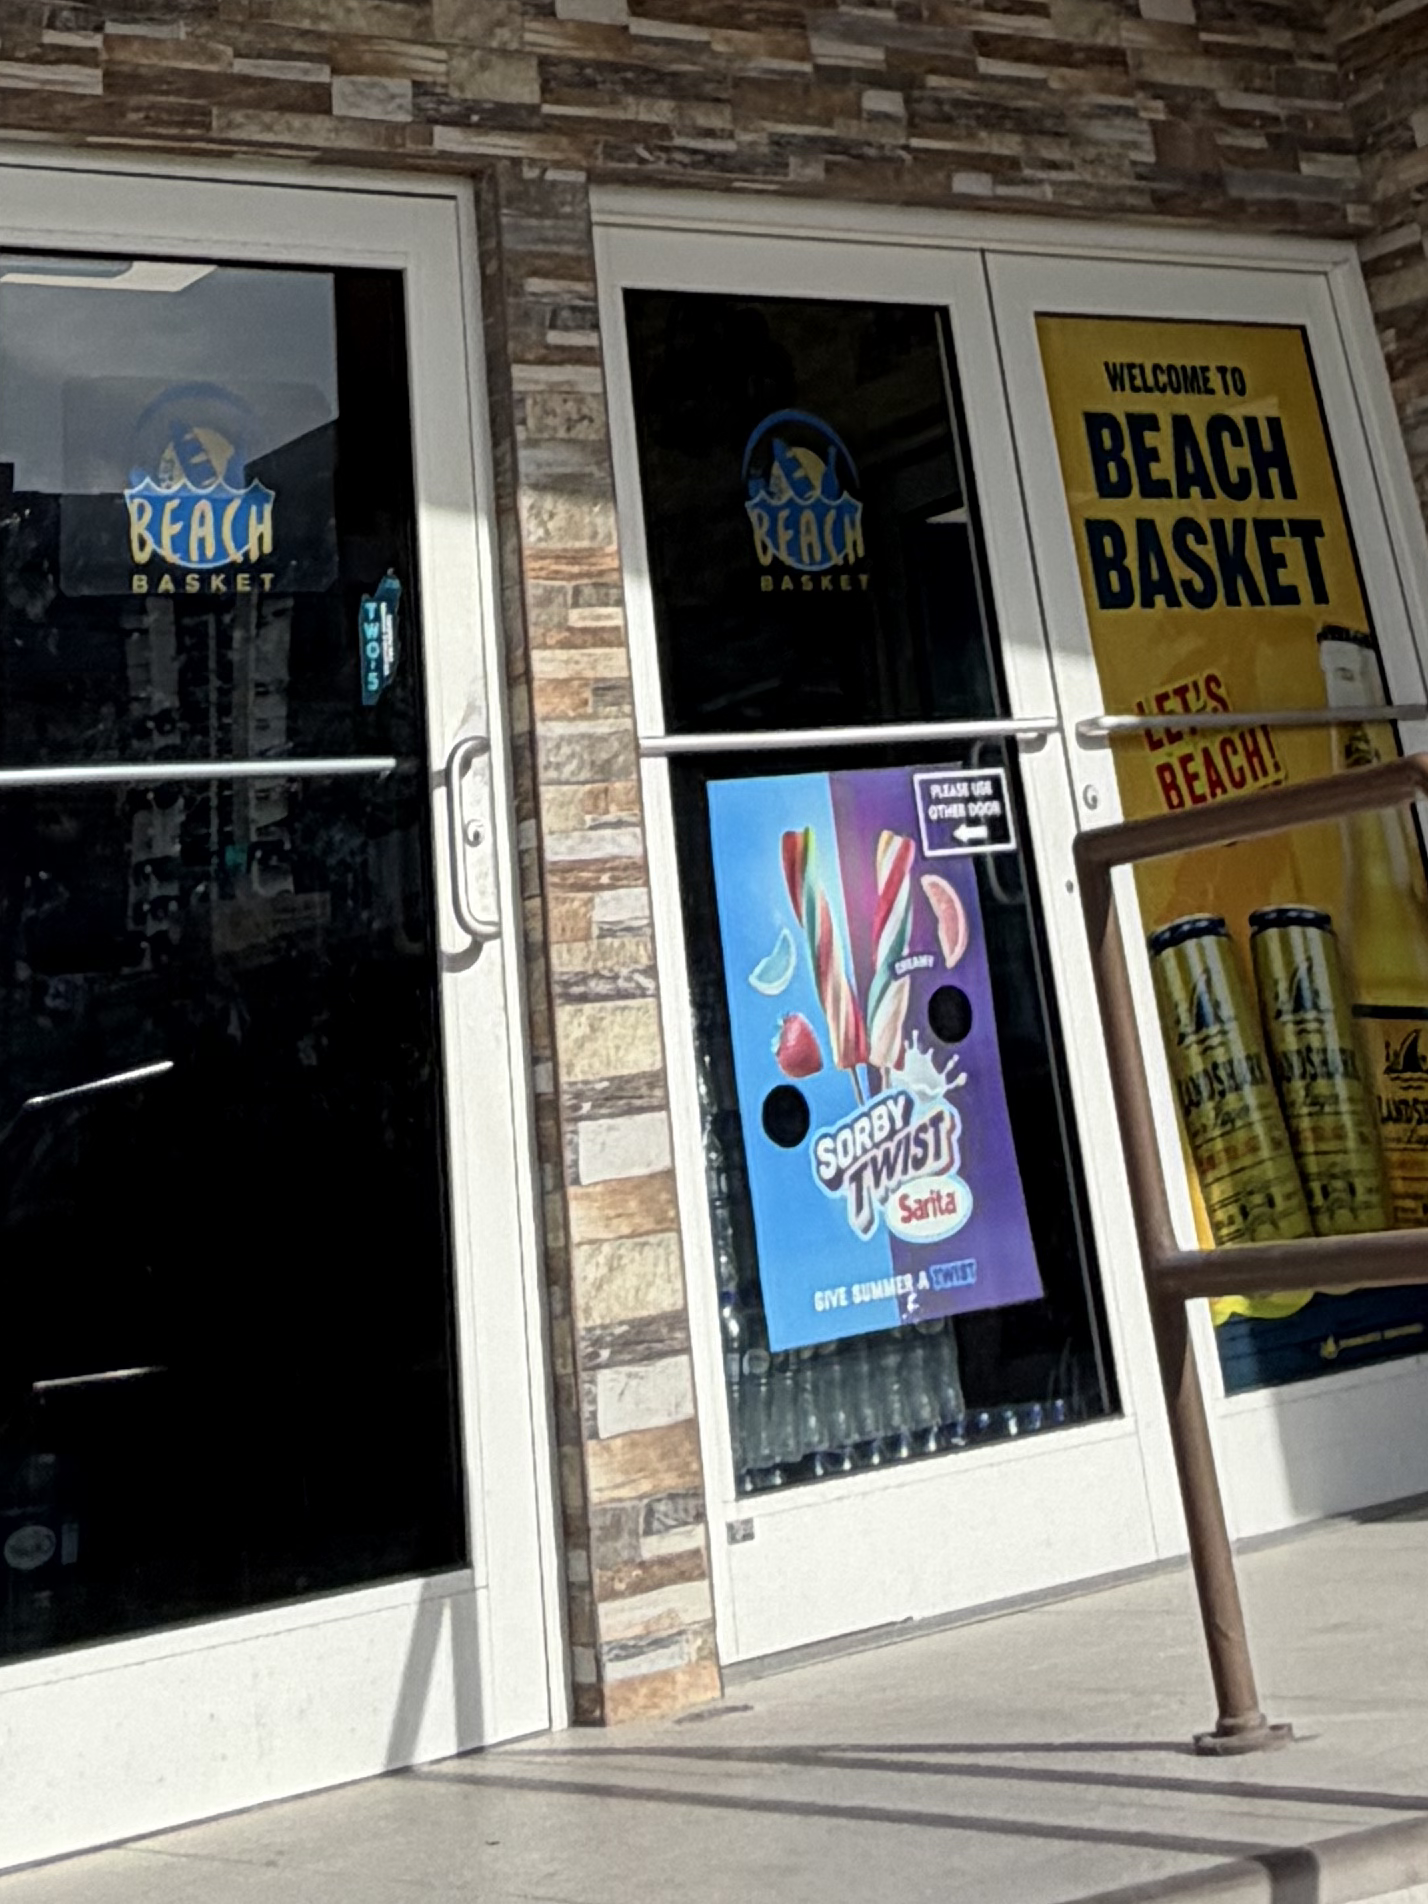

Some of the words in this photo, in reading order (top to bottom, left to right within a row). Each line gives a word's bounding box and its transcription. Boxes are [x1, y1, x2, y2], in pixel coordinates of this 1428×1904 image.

[1103, 360, 1215, 395] WELCOME
[1217, 365, 1248, 398] TO
[1082, 410, 1299, 502] BEACH
[127, 497, 275, 566] BEACH
[749, 507, 866, 568] BEACH
[131, 572, 276, 595] BASKET
[759, 573, 871, 594] BASKET
[1083, 517, 1331, 611] BASKET
[1135, 673, 1232, 753] LET'S
[929, 781, 970, 800] PLEASE
[1155, 724, 1282, 811] BEACH!
[927, 802, 967, 821] OTHER
[967, 800, 1002, 818] DOOR
[815, 1093, 906, 1181] SORBY
[847, 1108, 945, 1221] TWIST
[898, 1188, 958, 1225] Sarita
[814, 1287, 849, 1312] GIVE
[851, 1273, 914, 1305] SUMMER
[917, 1271, 930, 1290] A
[932, 1261, 976, 1289] TWIST
